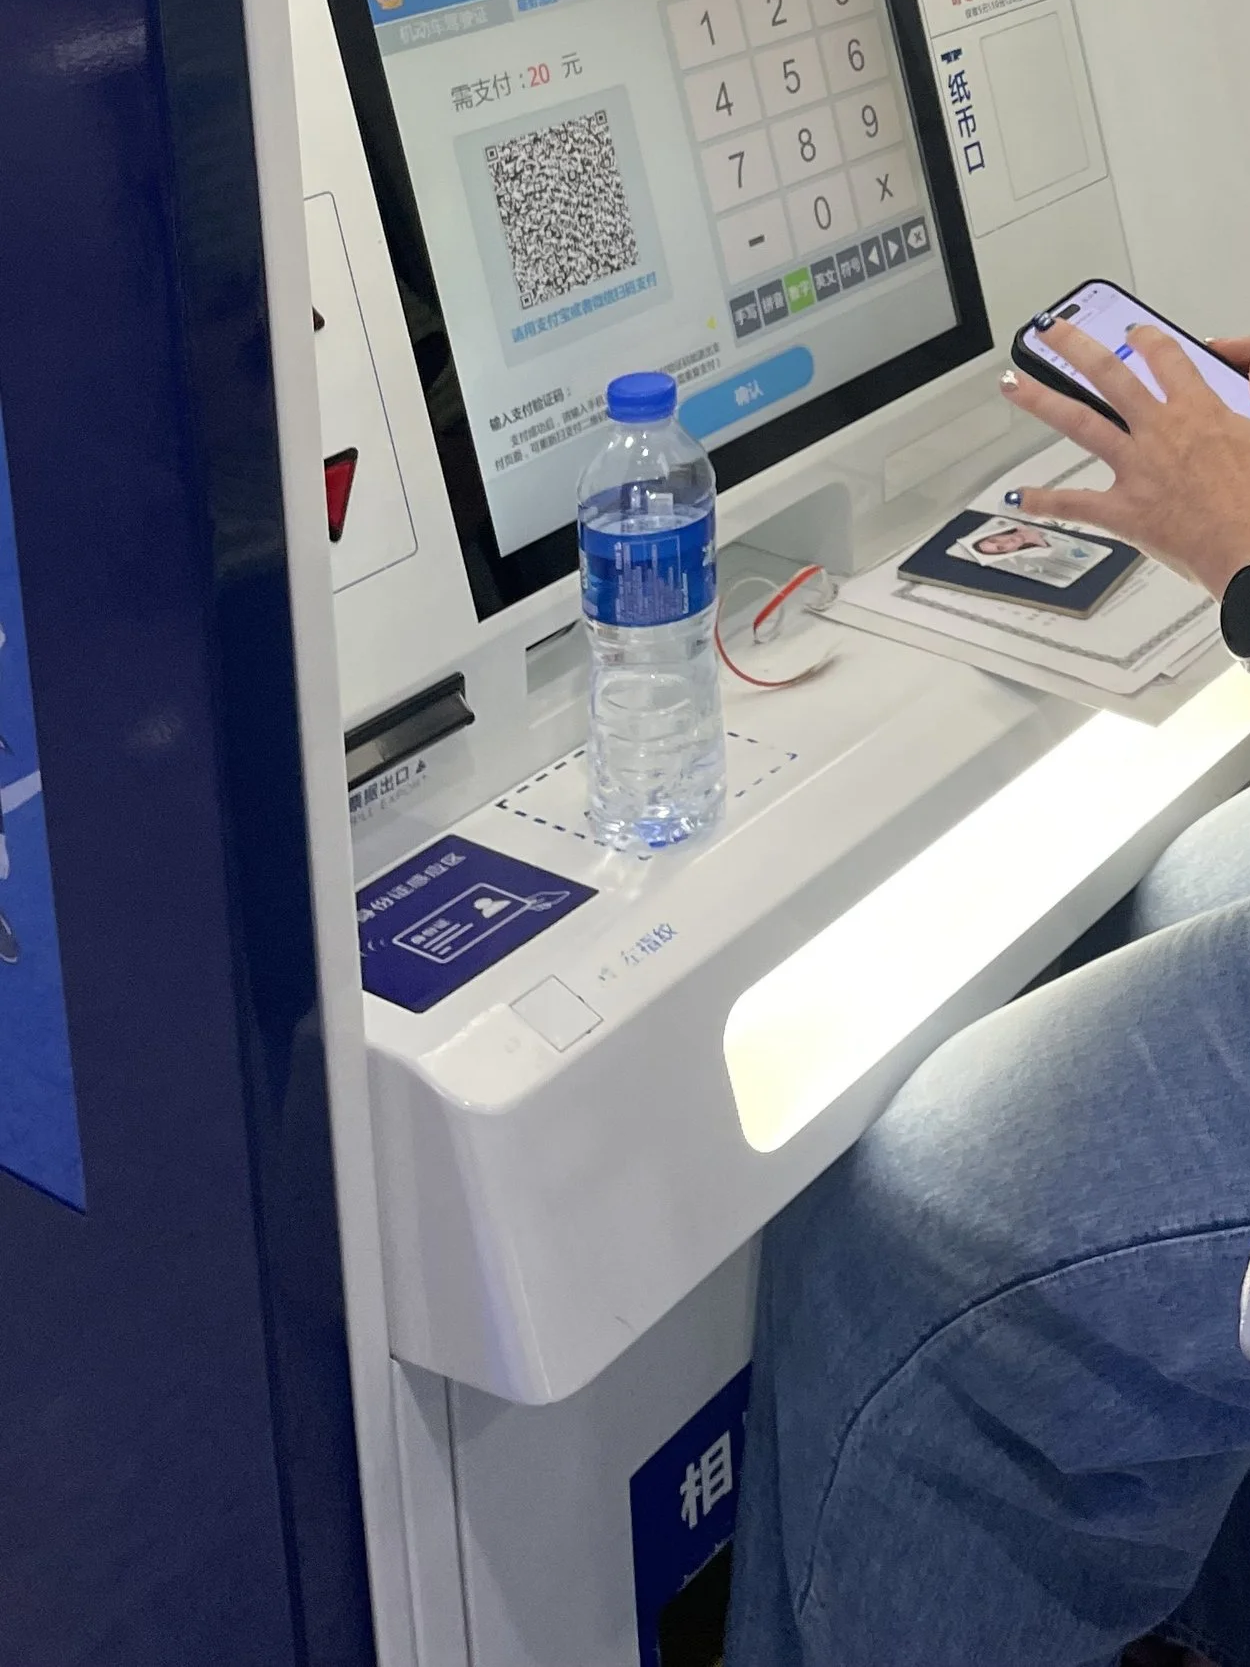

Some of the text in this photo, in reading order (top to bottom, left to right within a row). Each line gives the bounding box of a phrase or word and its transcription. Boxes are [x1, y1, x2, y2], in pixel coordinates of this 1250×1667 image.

[700, 10, 716, 46] 1
[561, 51, 584, 79] 元
[847, 38, 866, 72] 6
[782, 58, 801, 94] 5
[715, 81, 734, 117] 4
[861, 104, 879, 138] 9
[948, 69, 986, 175] 纸币口
[798, 127, 817, 163] 8
[728, 150, 745, 189] 7
[813, 195, 832, 231] 0
[679, 1412, 748, 1531] 相
